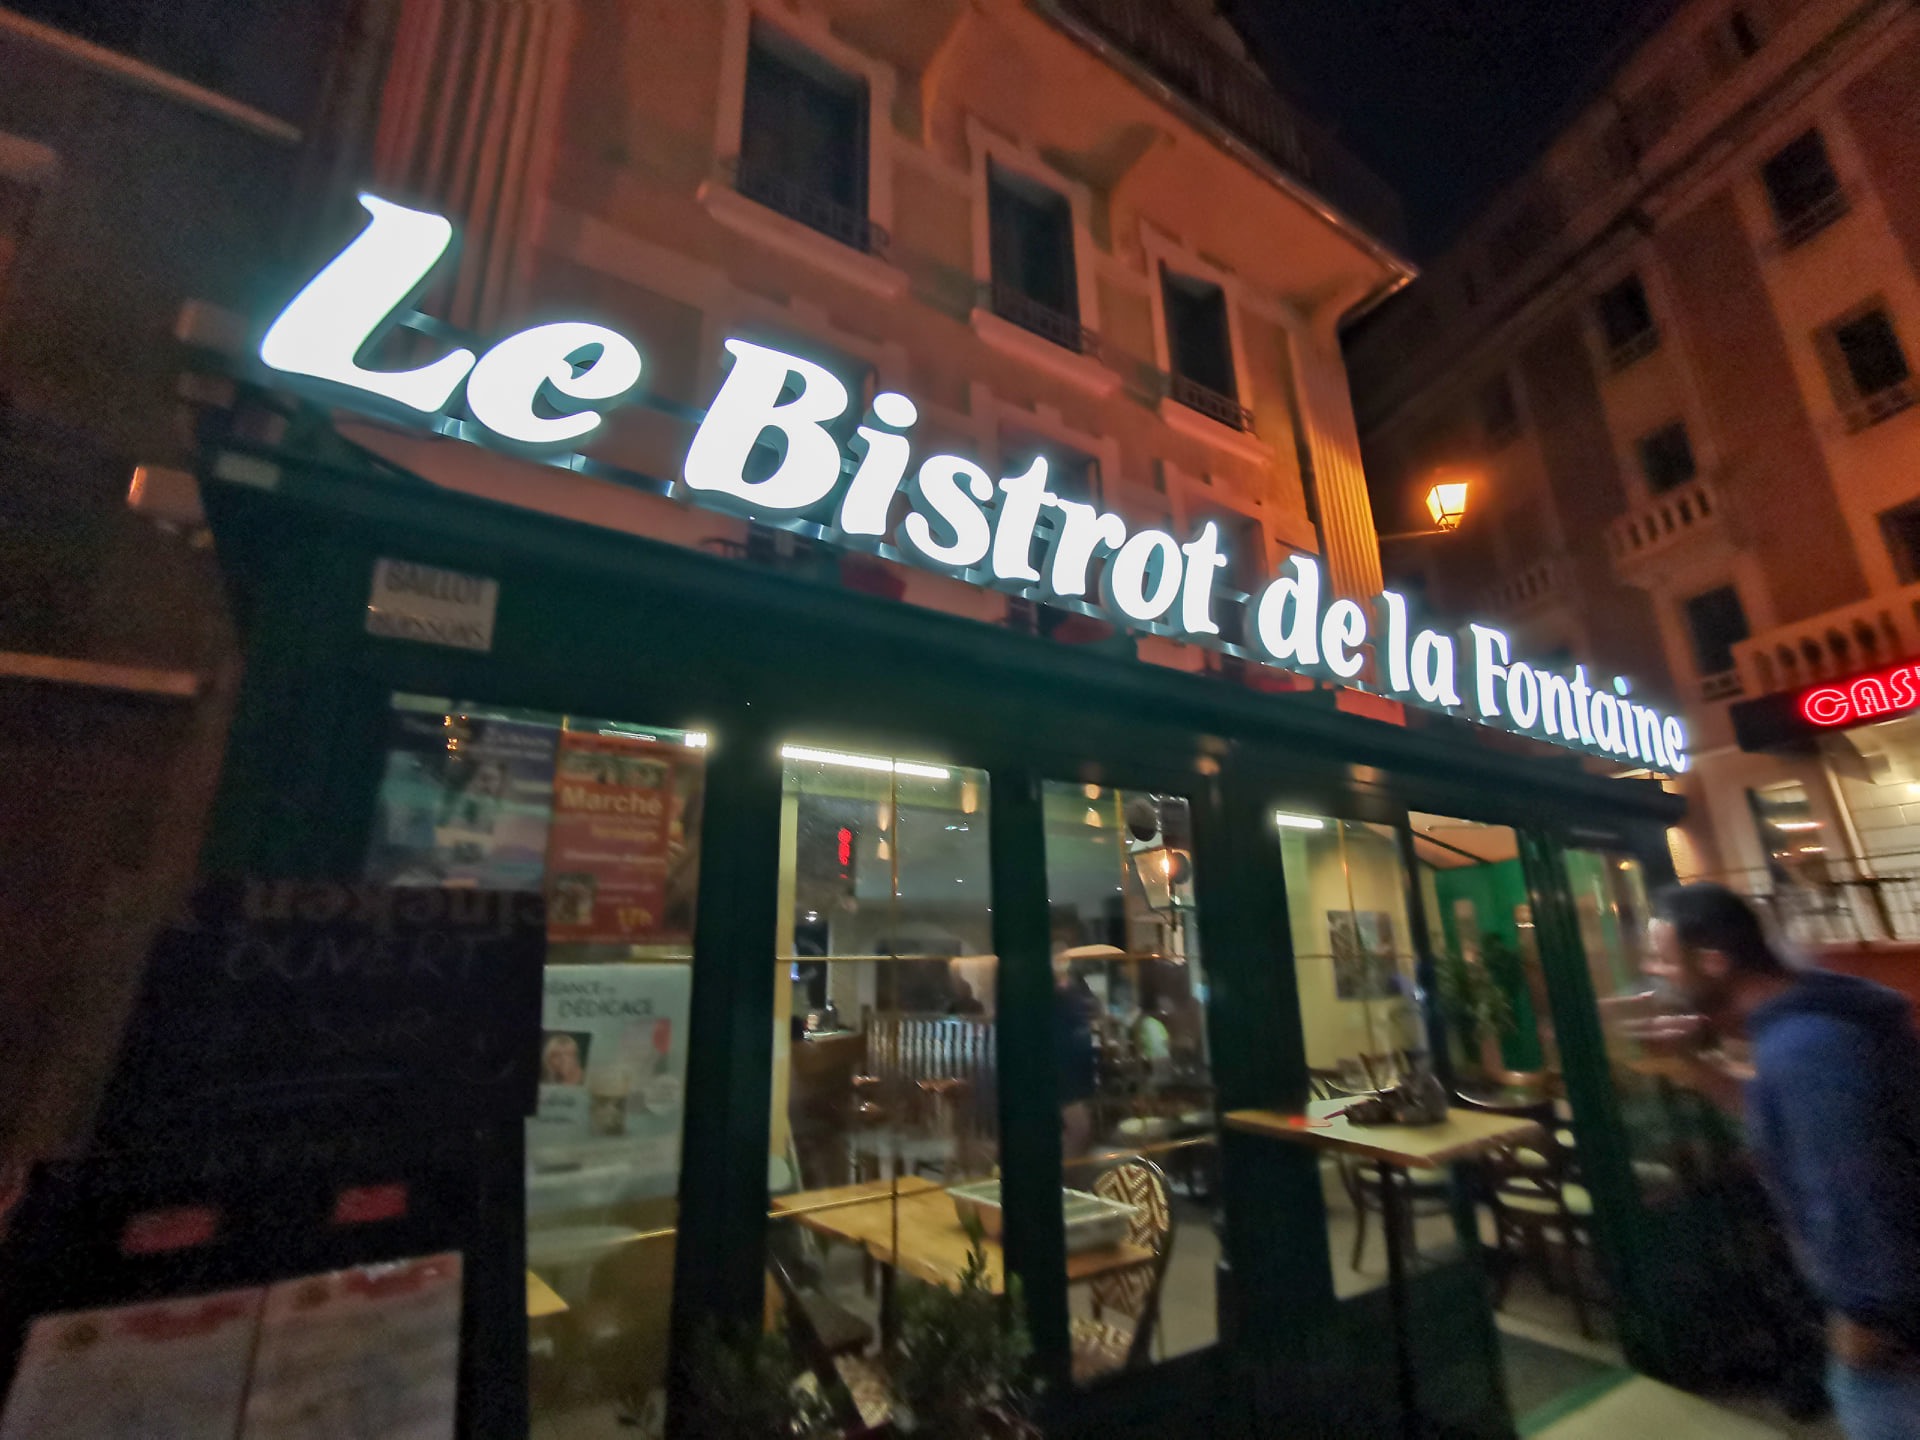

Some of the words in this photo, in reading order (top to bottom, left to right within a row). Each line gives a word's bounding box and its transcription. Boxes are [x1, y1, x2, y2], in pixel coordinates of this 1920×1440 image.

[261, 195, 642, 443] Le
[683, 338, 1228, 635] Bistrot
[1257, 554, 1366, 678] de
[1382, 590, 1461, 706] la
[1470, 622, 1688, 774] Fontaine
[1804, 665, 1920, 725] CAS
[559, 783, 663, 816] Marché
